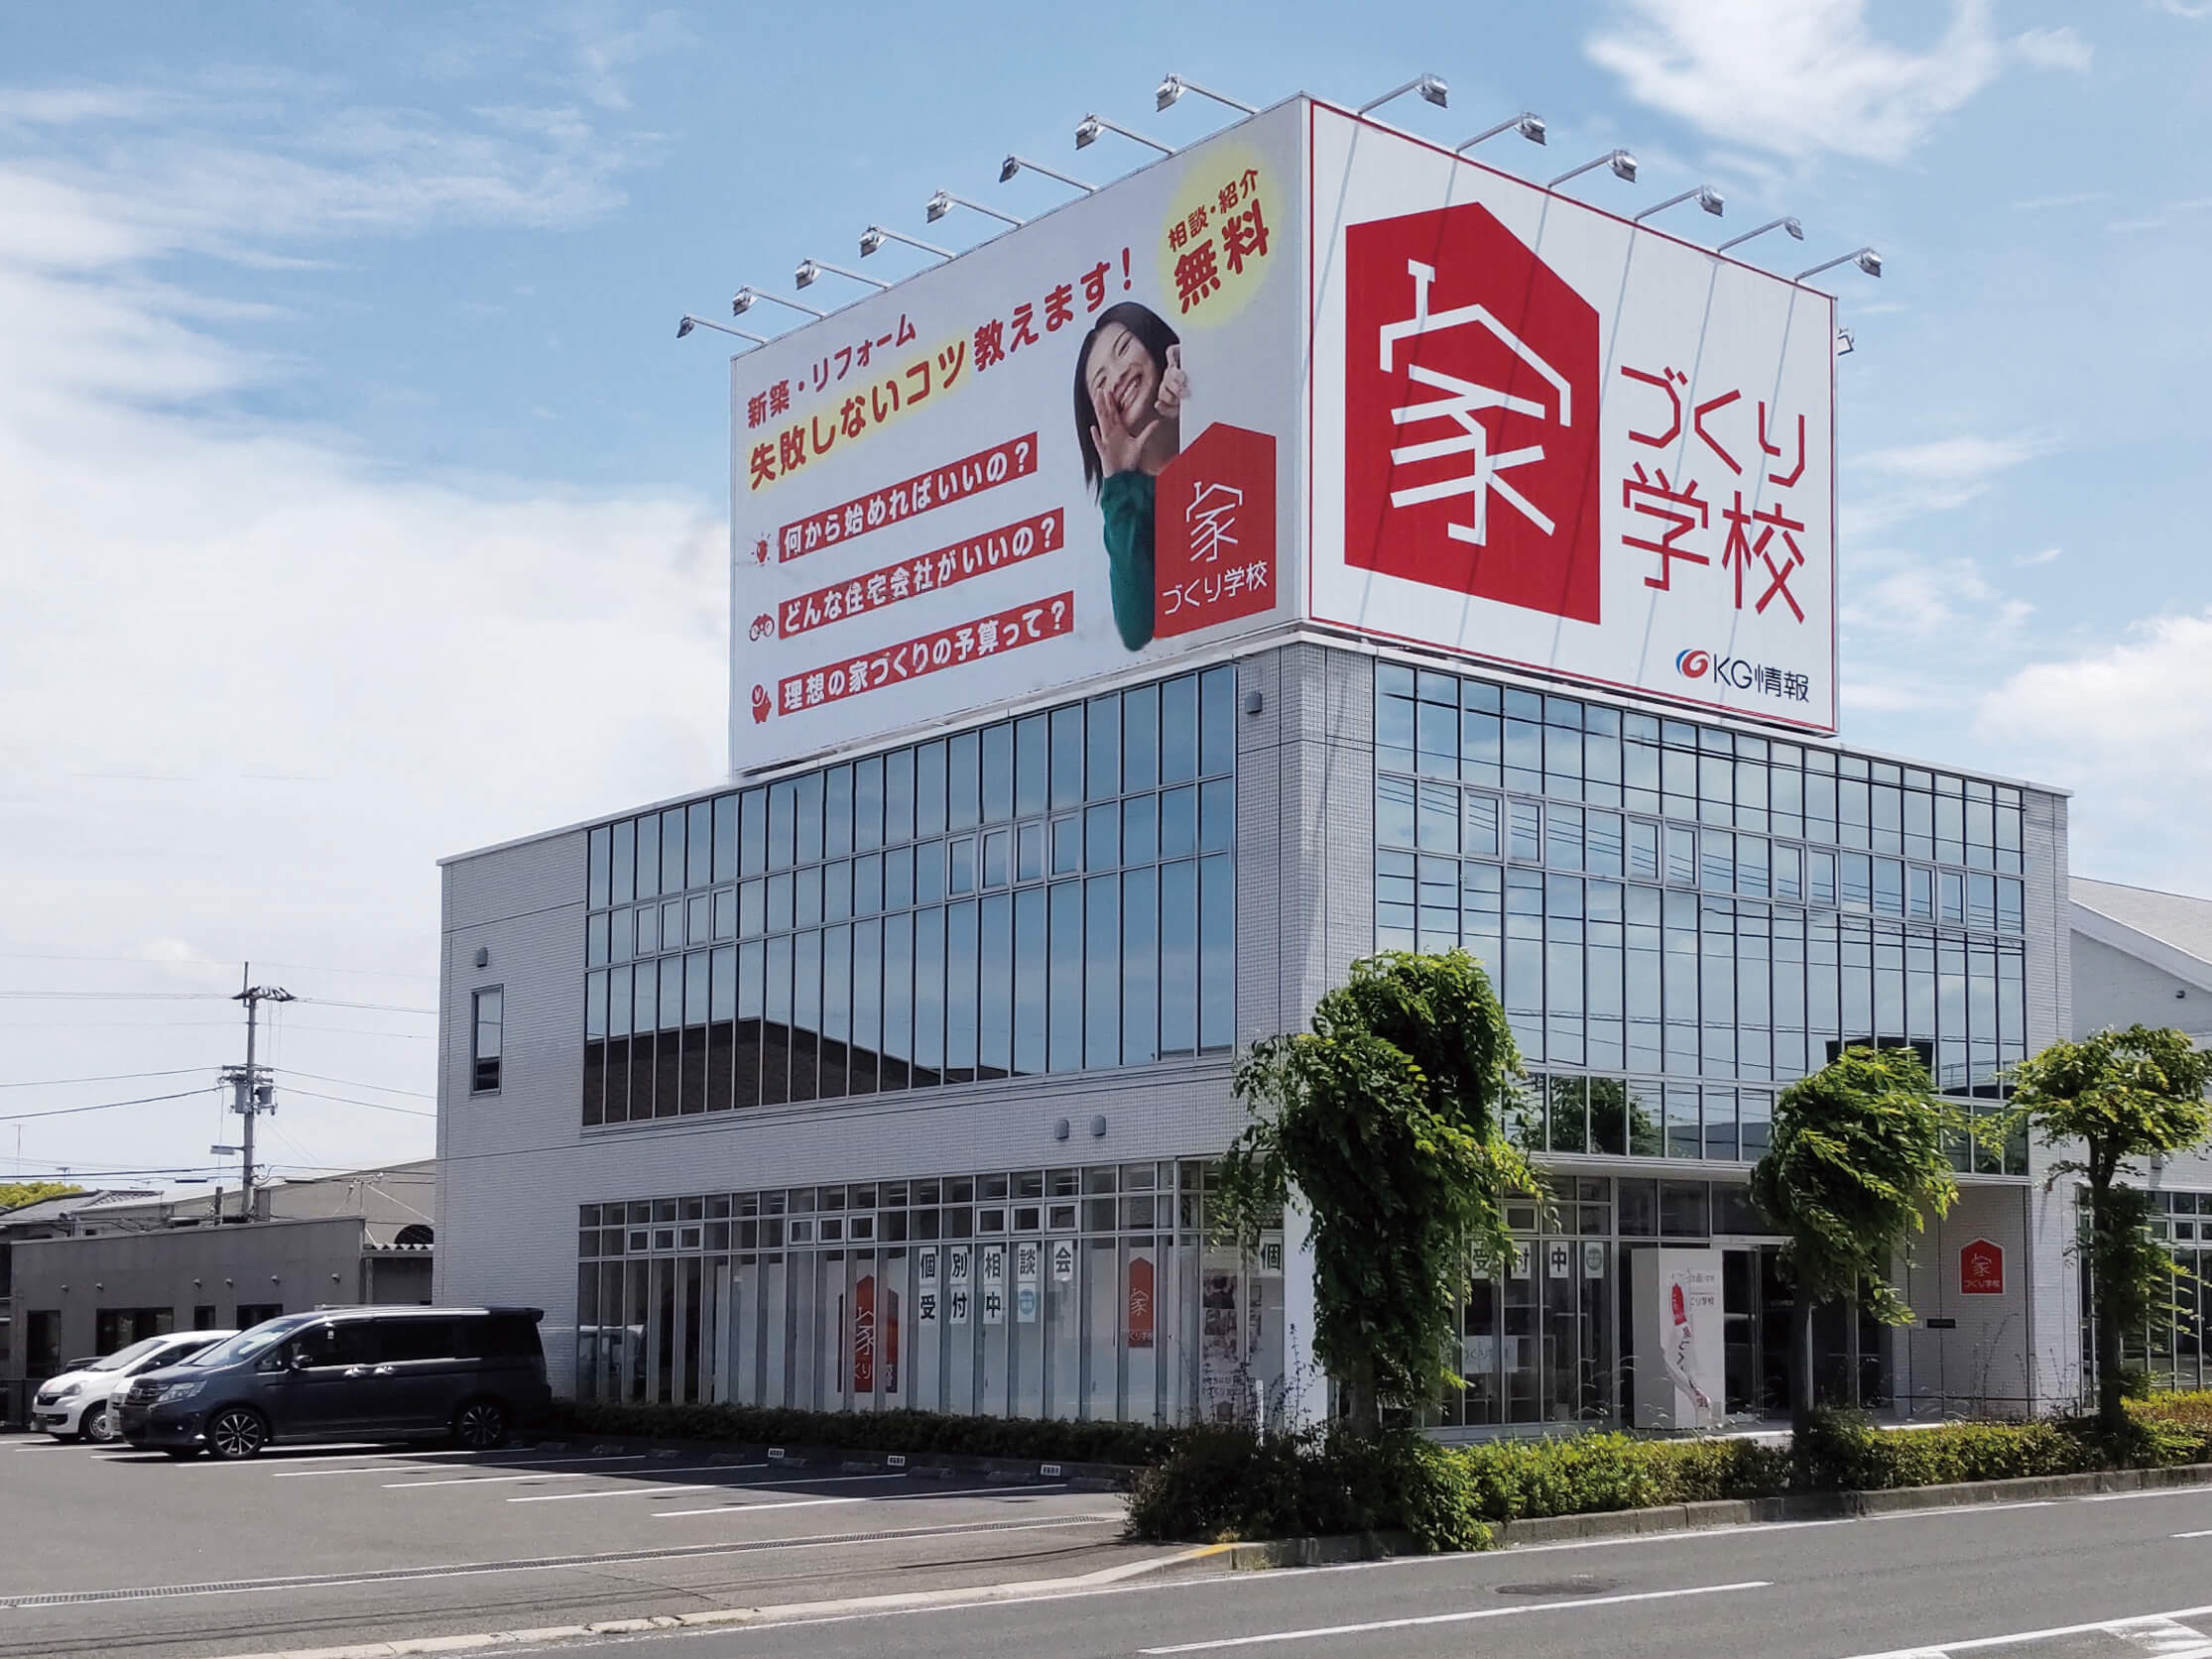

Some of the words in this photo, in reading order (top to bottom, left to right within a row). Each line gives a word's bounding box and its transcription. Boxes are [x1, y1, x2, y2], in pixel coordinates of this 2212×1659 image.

[1167, 169, 1259, 253] 相談・紹介
[1174, 197, 1270, 314] 無料
[747, 313, 917, 429] 新築・リフォーム
[1379, 258, 1571, 547] 家
[1620, 365, 1806, 488] づくり
[784, 440, 1029, 559] 何から始めればいいの？
[1185, 480, 1243, 562] 家
[1621, 461, 1806, 625] 学校
[784, 516, 1055, 633] どんな住宅会社がいいの？
[1162, 559, 1269, 616] づくり学校
[784, 599, 1065, 711] 理想の家づくりの予算って？
[1713, 652, 1810, 704] KG情報
[920, 1290, 1002, 1321] 受付中
